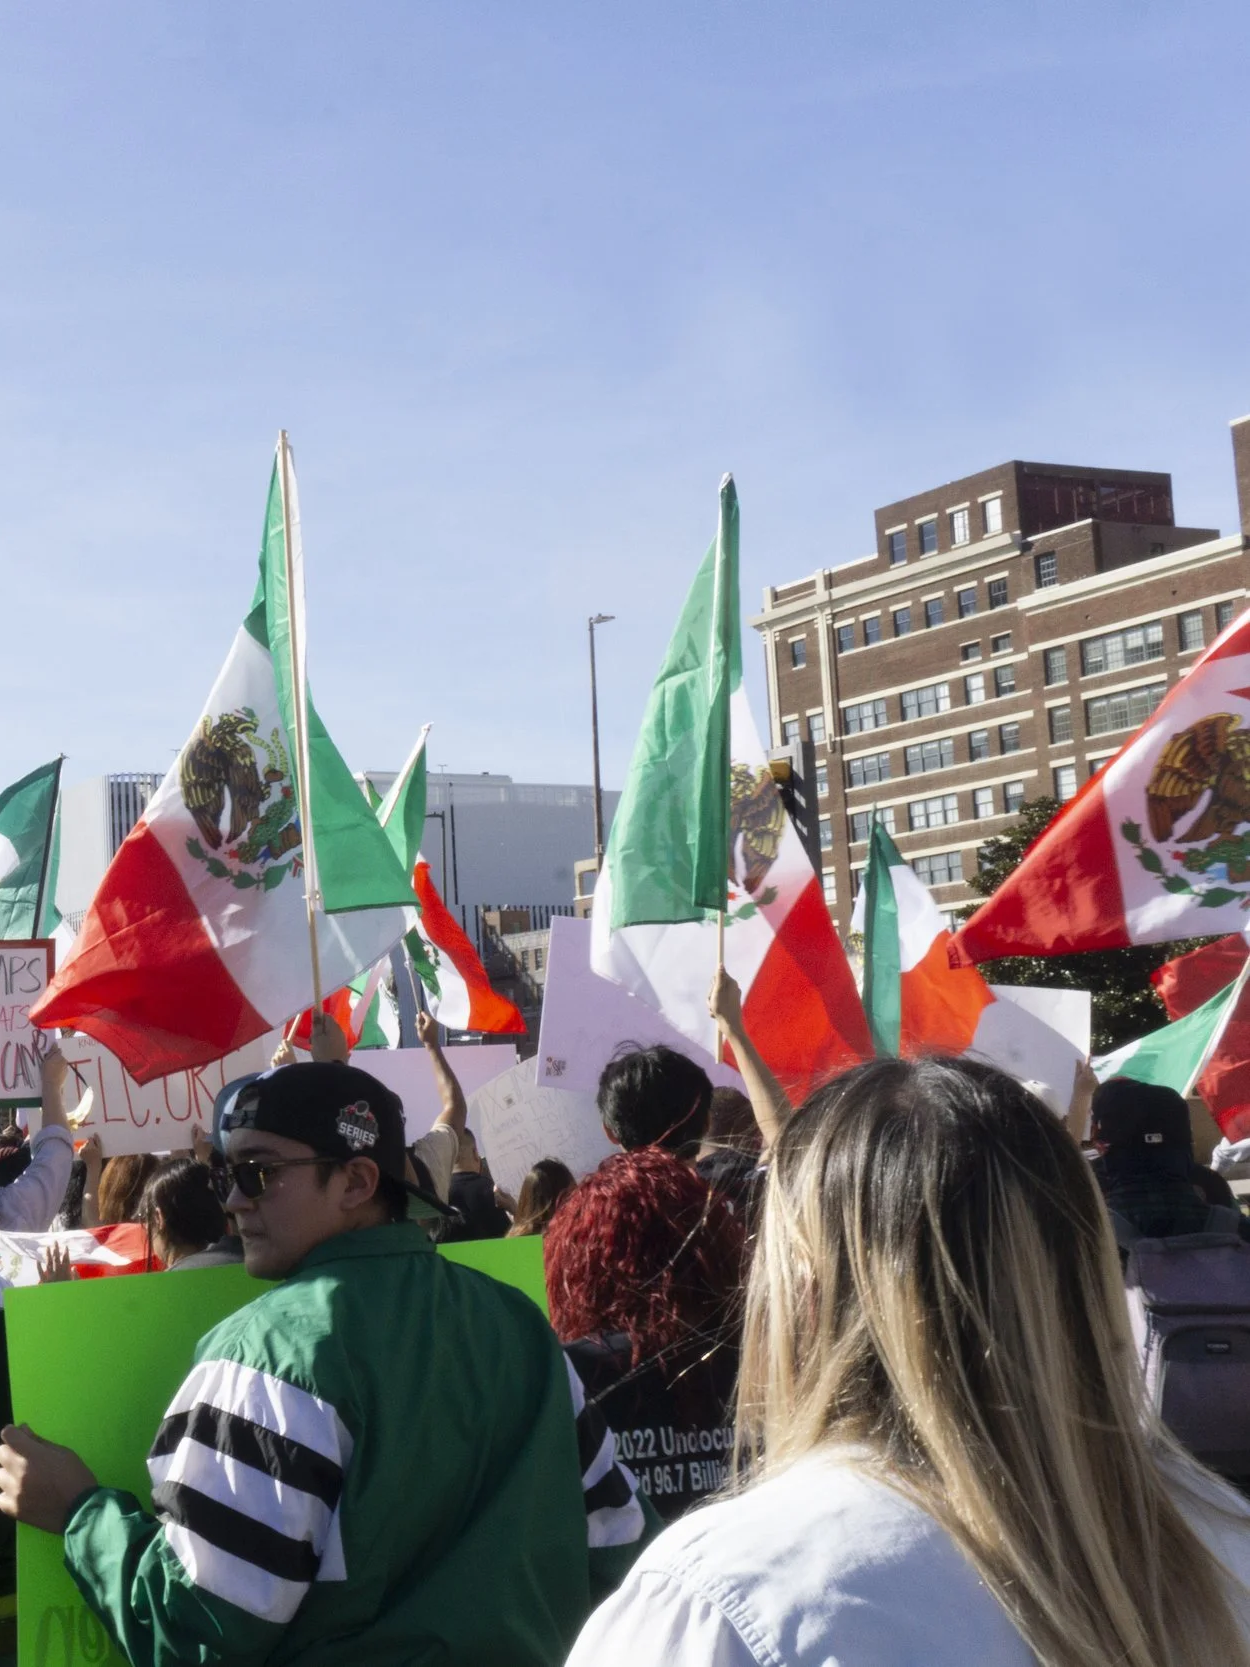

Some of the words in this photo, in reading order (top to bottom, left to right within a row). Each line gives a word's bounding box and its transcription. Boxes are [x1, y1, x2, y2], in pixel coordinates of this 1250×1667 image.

[338, 1121, 376, 1146] SERIES
[614, 1427, 658, 1461] 2022
[659, 1423, 736, 1456] Undocu
[654, 1463, 684, 1495] 96.7
